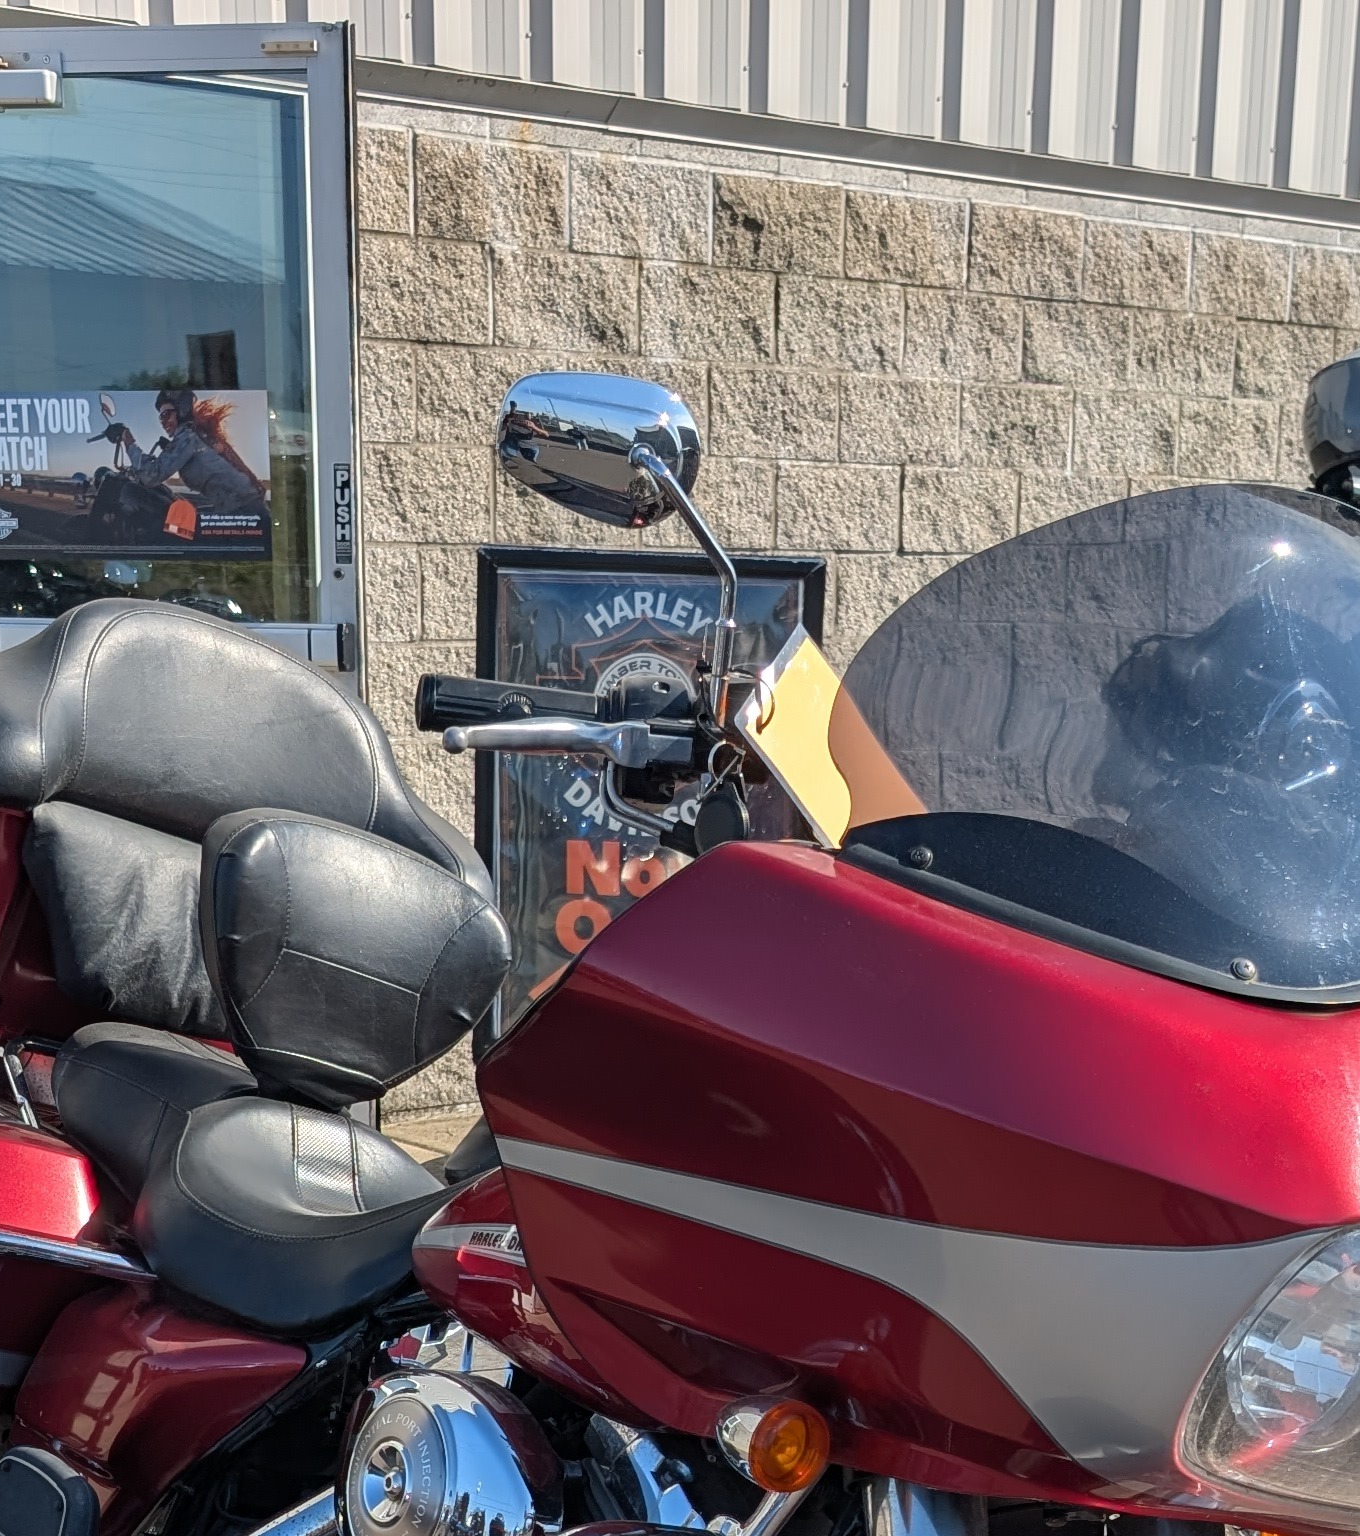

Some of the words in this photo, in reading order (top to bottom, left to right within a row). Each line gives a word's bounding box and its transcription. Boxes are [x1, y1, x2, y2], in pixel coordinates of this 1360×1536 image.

[33, 398, 92, 433] YOUR
[11, 473, 22, 487] 30
[335, 470, 351, 541] PUSH
[584, 591, 714, 638] HARLEY
[601, 660, 652, 695] IMBER
[396, 1412, 422, 1438] PORT
[411, 1439, 432, 1530] INJECTION
